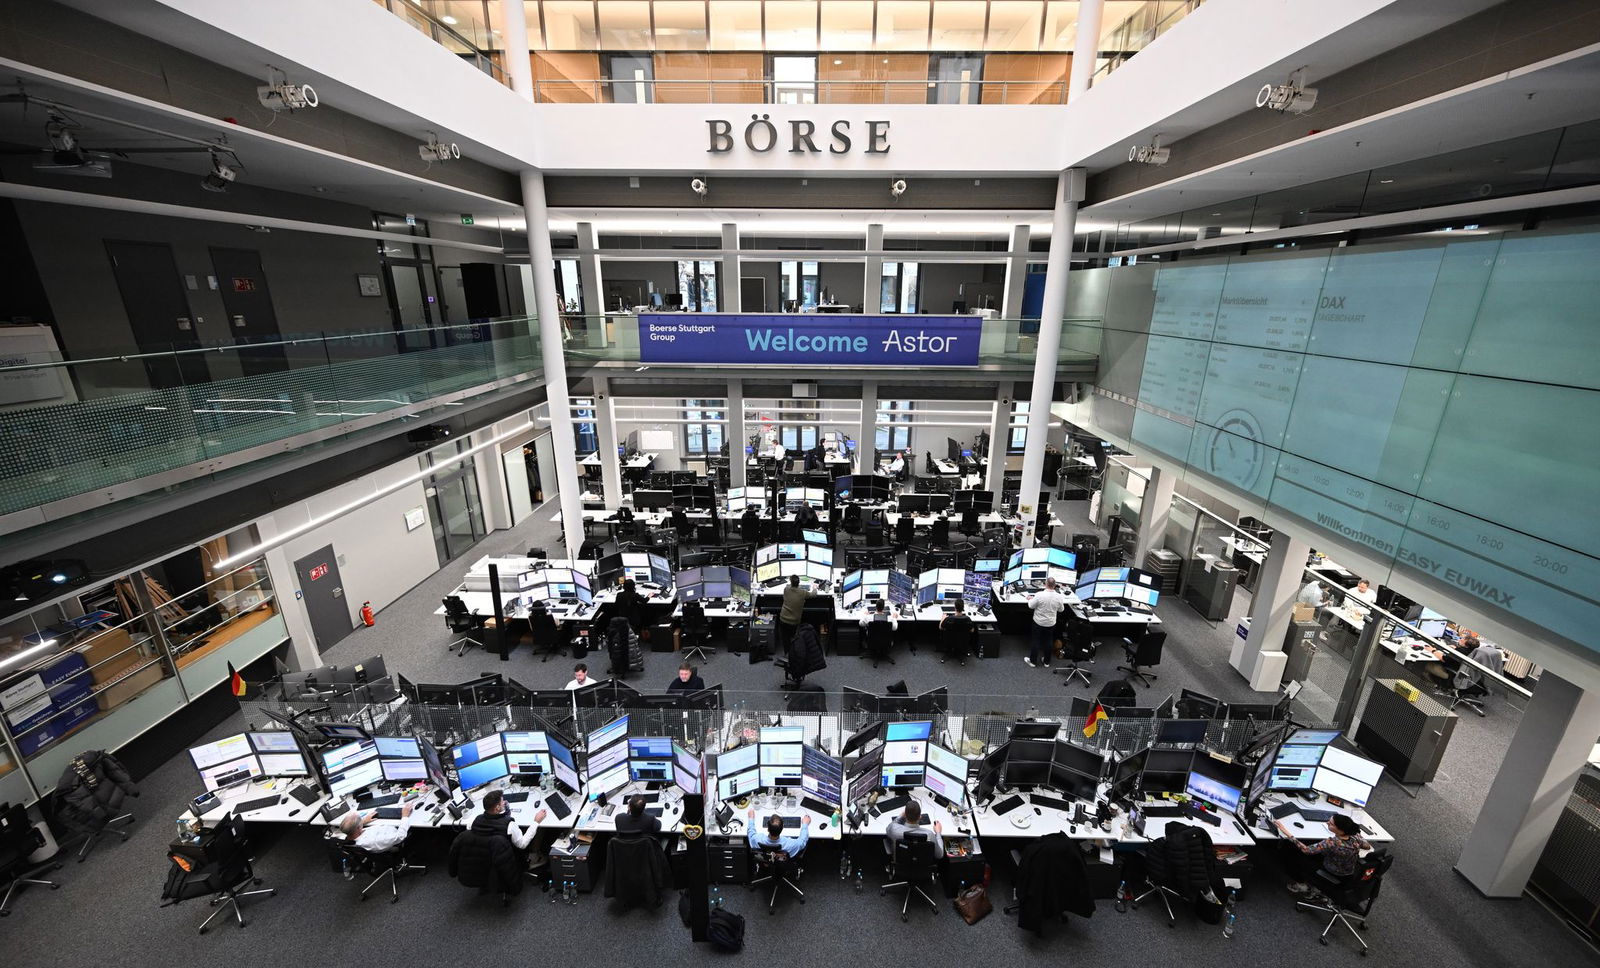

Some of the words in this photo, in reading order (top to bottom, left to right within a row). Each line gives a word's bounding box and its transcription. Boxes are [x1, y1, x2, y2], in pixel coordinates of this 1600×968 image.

[705, 113, 891, 154] BÖRSE
[1320, 296, 1346, 309] DAX
[650, 324, 677, 333] Boerse
[678, 324, 715, 335] Stuttgart
[650, 333, 675, 343] Group
[745, 329, 868, 352] Welcome
[882, 329, 957, 353] Astor
[1426, 515, 1450, 531] 16:00
[1532, 554, 1569, 576] 20:00
[1316, 511, 1394, 554] Willkommen
[1398, 546, 1442, 580] EASY
[1444, 568, 1516, 609] EUWAX
